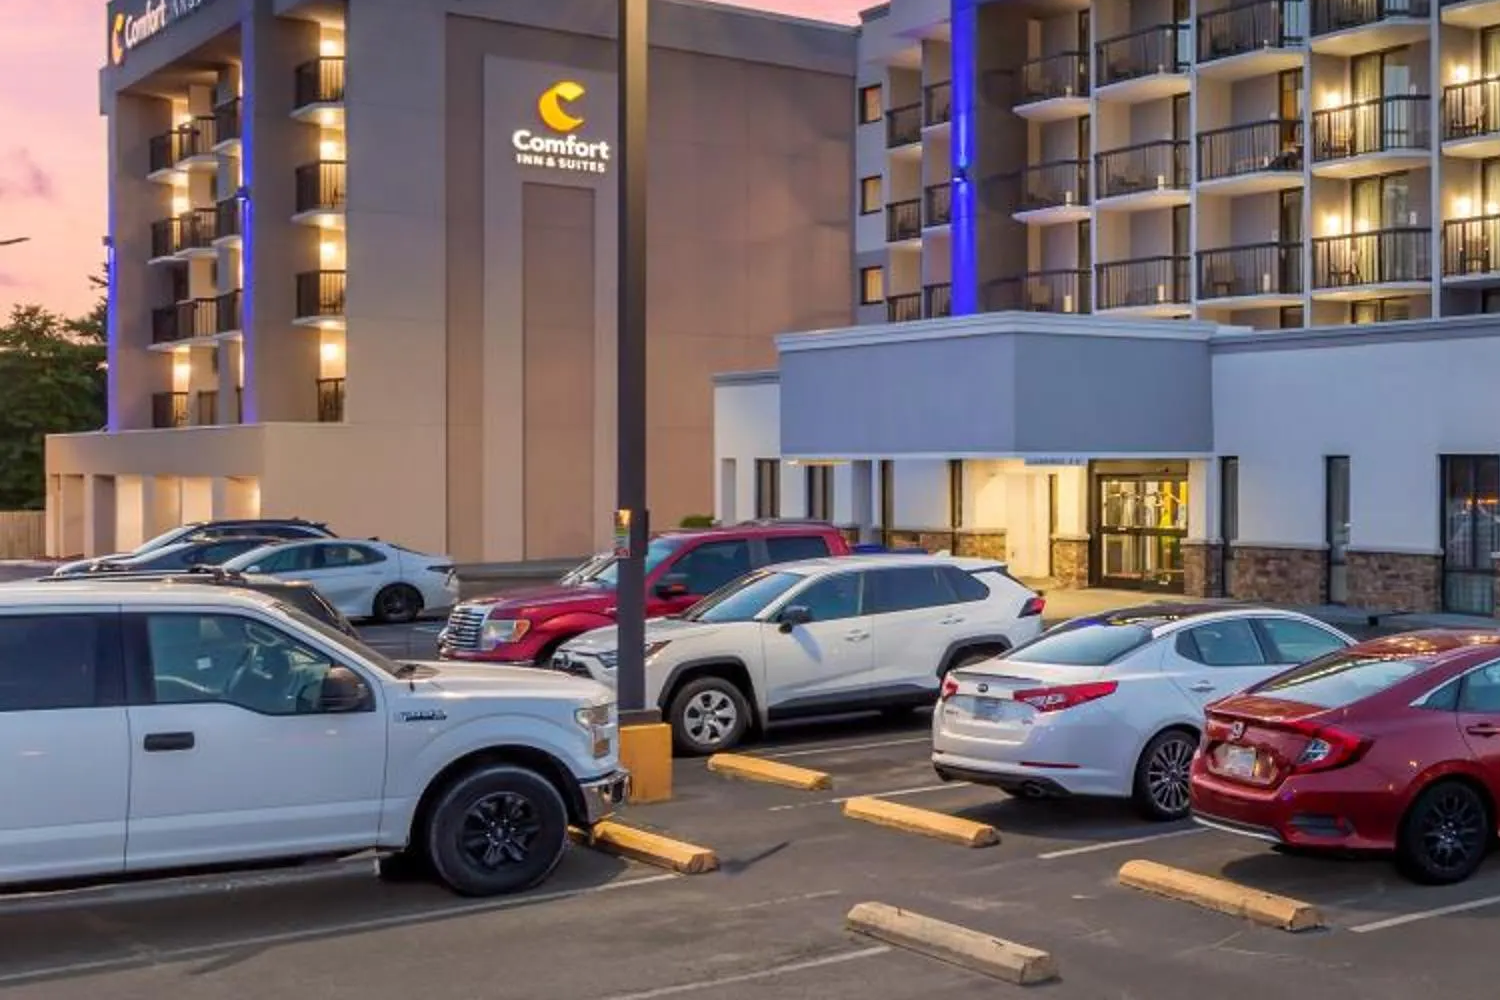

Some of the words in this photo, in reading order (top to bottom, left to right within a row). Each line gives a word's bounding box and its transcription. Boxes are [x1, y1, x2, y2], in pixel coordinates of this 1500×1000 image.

[511, 129, 610, 160] Comfort
[516, 153, 544, 166] INN
[545, 156, 556, 168] &
[558, 157, 605, 173] SUITES
